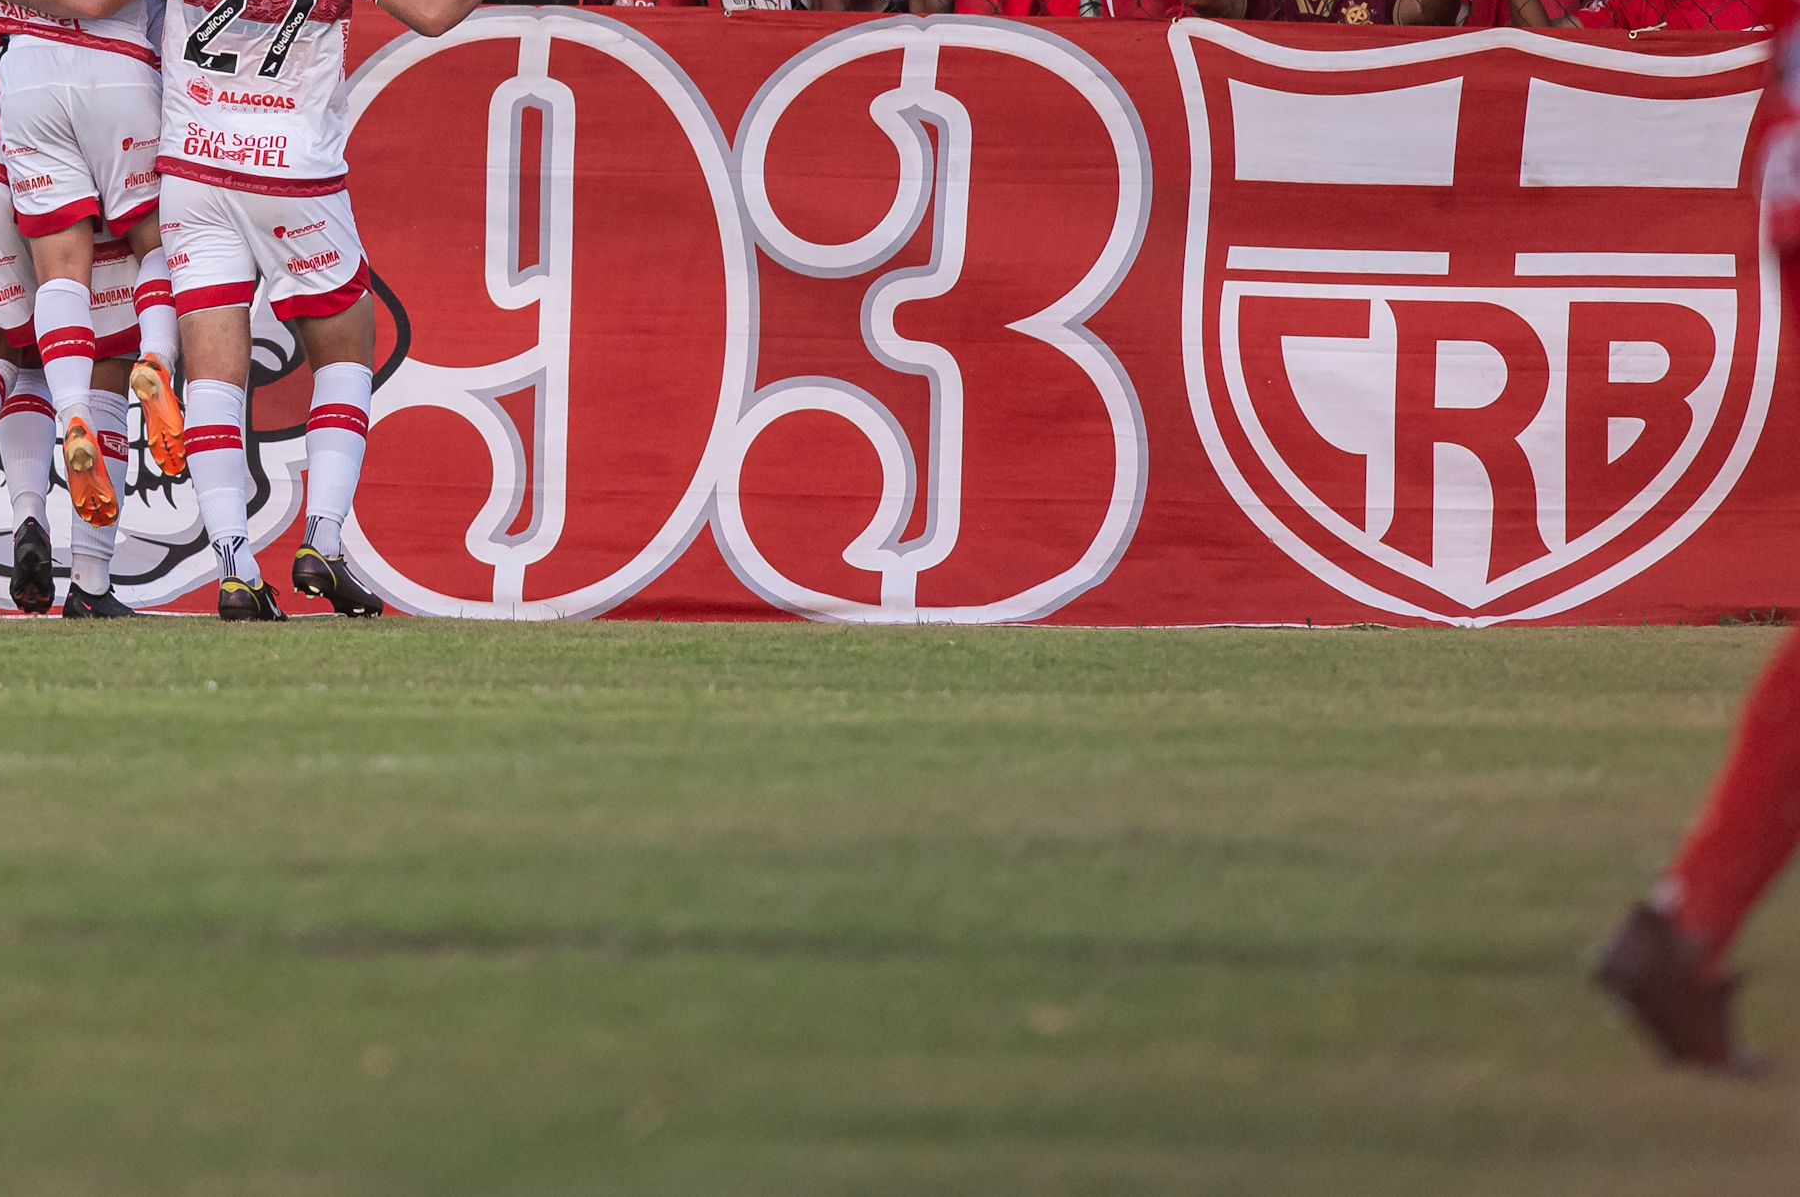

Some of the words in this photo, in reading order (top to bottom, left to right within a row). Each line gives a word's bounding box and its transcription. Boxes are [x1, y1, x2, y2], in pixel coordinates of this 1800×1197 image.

[196, 6, 234, 42] QualiCoco
[272, 11, 305, 56] QualiCoco
[217, 90, 296, 110] ALAGOAS
[287, 220, 327, 238] prevencor
[287, 250, 340, 274] PINDORAMA
[1237, 298, 1717, 586] CRB
